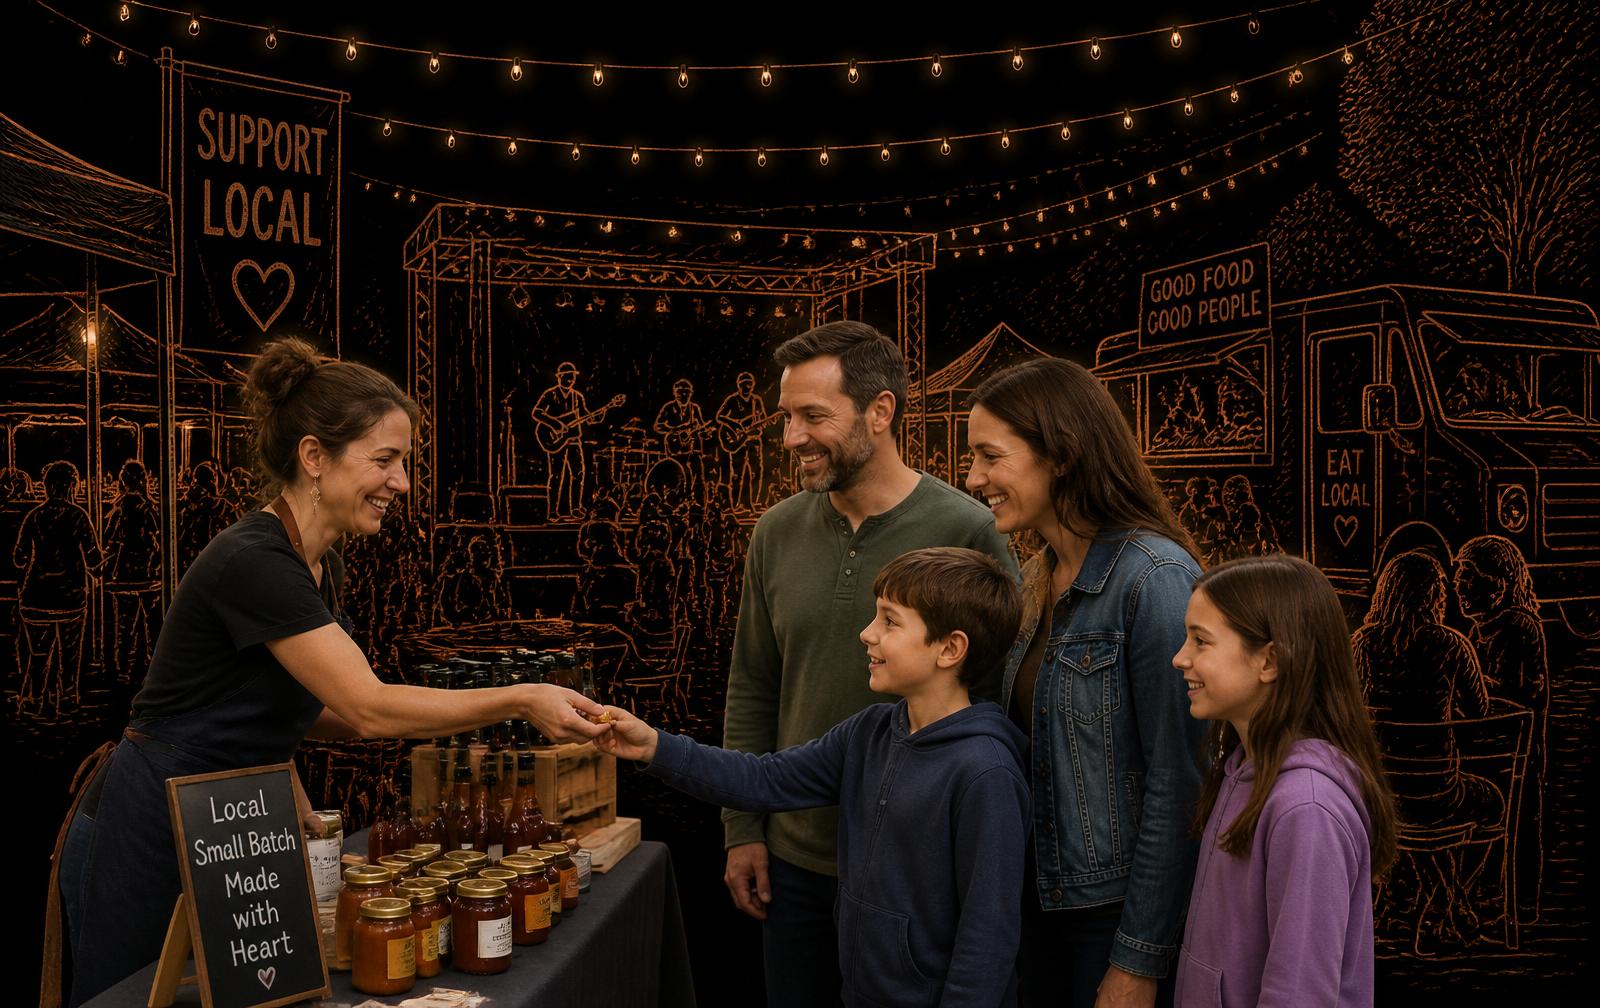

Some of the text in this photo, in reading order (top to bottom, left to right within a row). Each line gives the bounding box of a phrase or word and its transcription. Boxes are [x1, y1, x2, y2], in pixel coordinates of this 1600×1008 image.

[198, 107, 327, 175] SUPPORT
[204, 179, 321, 246] LOCAL
[1151, 259, 1253, 302] GOOD FOOD
[1148, 290, 1261, 334] GOOD PEOPLE
[1328, 449, 1364, 475] EAT
[1322, 483, 1370, 506] LOCAL
[210, 789, 268, 824] Local
[194, 828, 296, 866] Small Batch
[225, 867, 280, 898] Made
[233, 900, 279, 930] with
[230, 931, 294, 967] Heart
